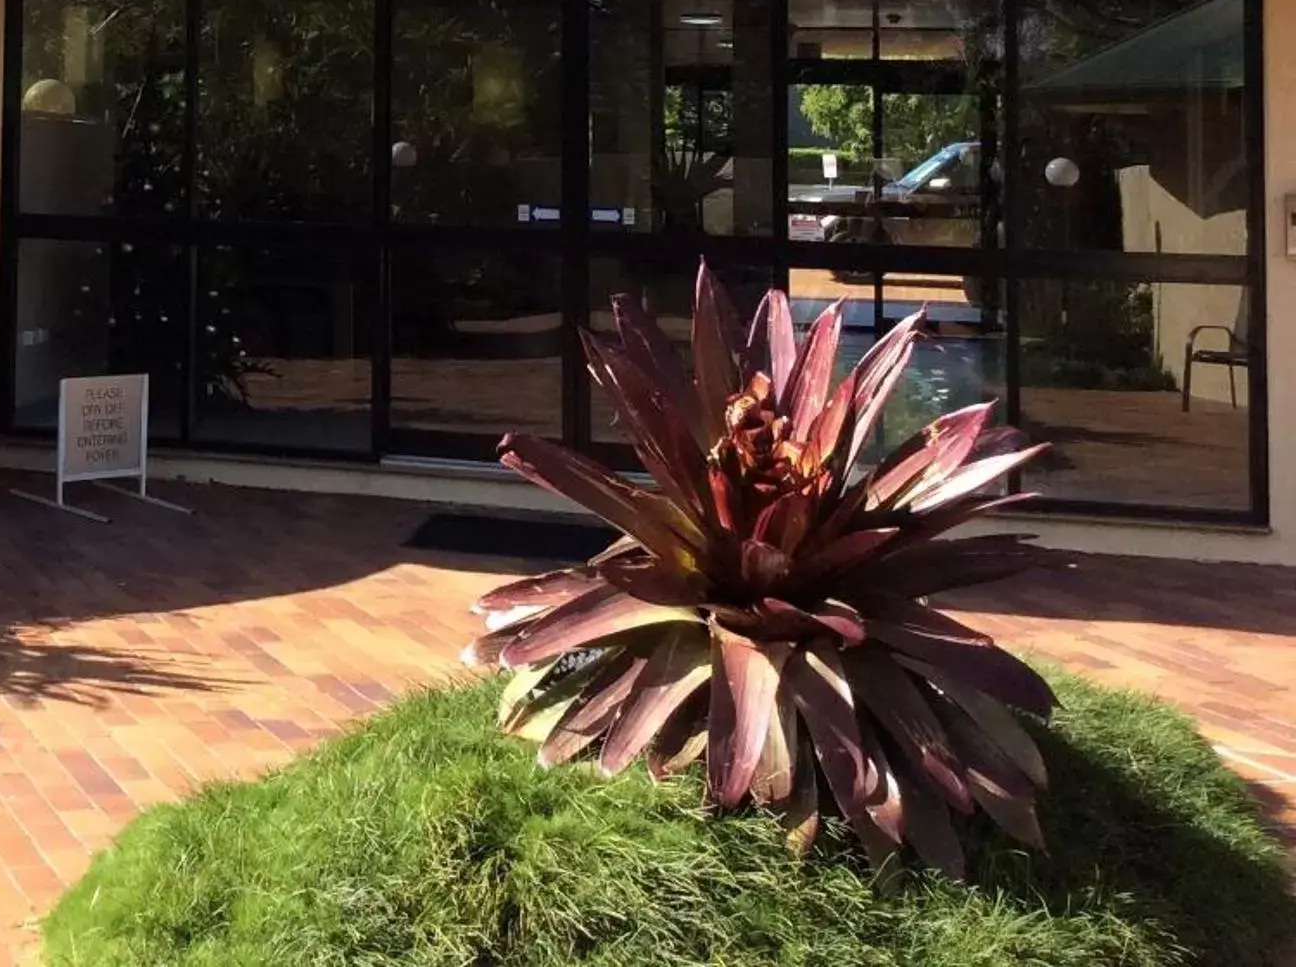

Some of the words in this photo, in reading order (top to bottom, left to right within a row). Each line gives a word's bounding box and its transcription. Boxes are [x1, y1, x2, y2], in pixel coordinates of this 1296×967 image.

[85, 388, 124, 400] PLEASE
[83, 418, 124, 431] BEFORE
[77, 432, 128, 448] ENTERING
